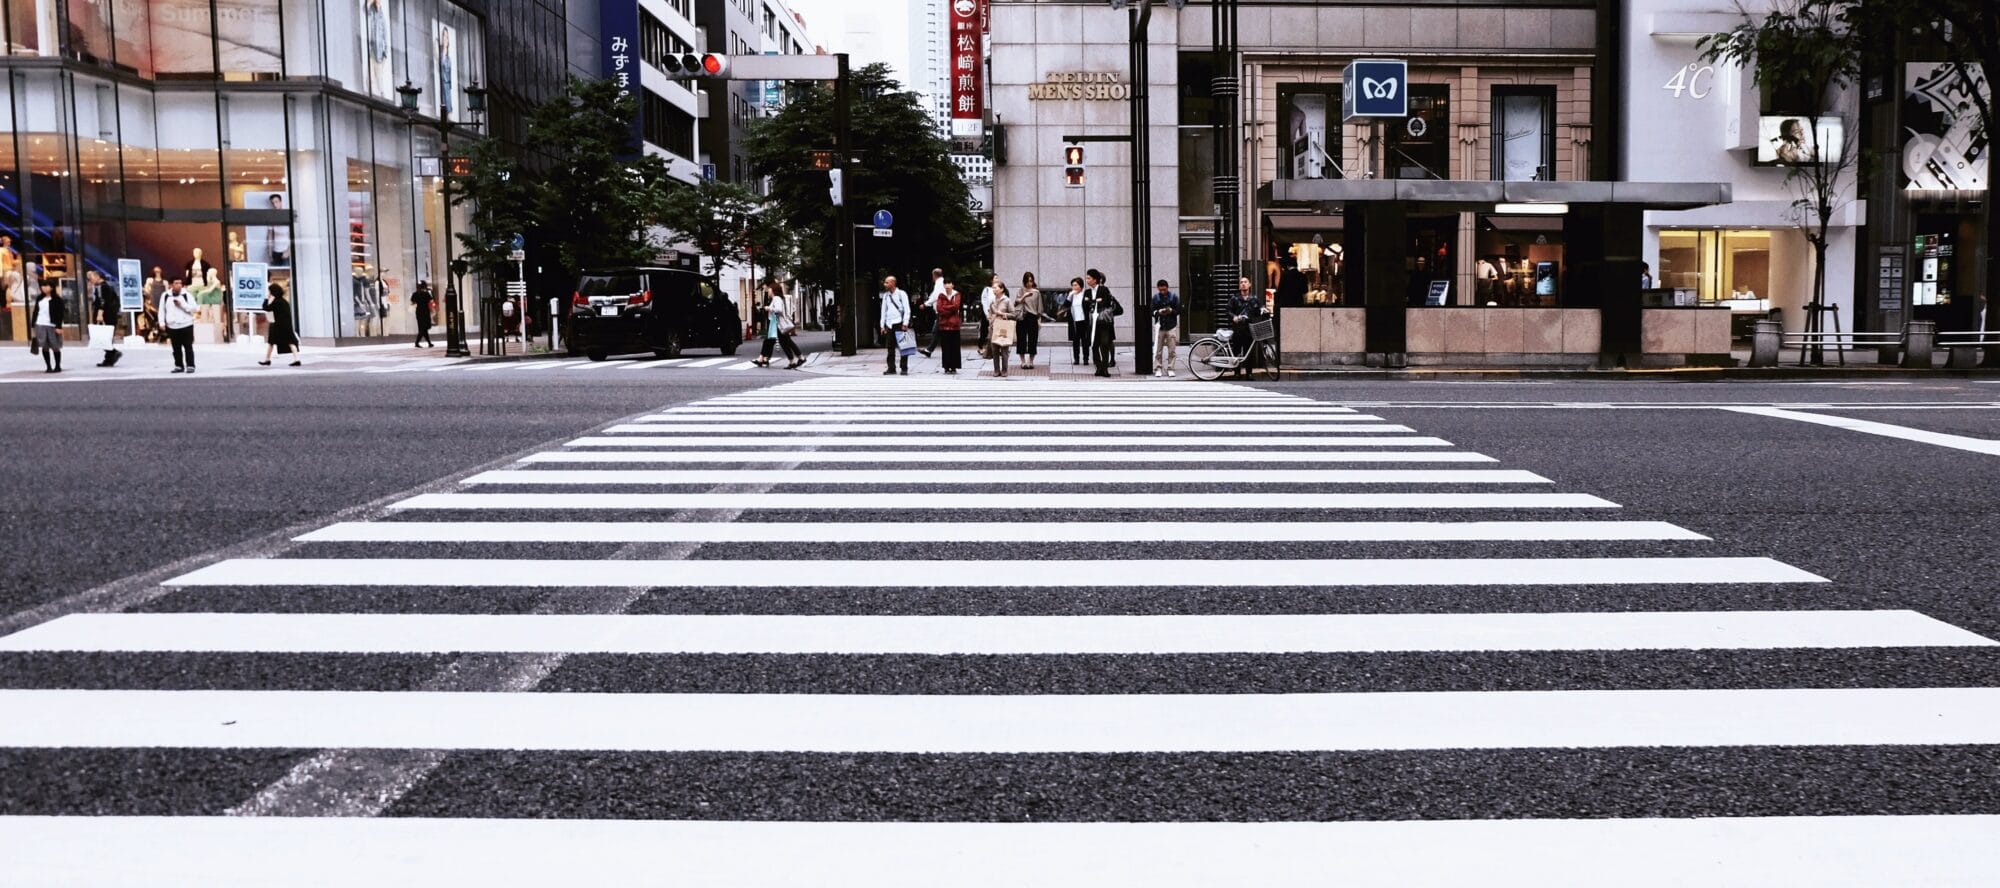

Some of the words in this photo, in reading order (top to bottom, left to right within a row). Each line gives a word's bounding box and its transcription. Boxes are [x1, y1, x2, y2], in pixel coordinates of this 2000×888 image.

[1046, 71, 1120, 84] TEIJIN
[1028, 84, 1082, 101] MEN'S
[238, 279, 262, 290] 50%
